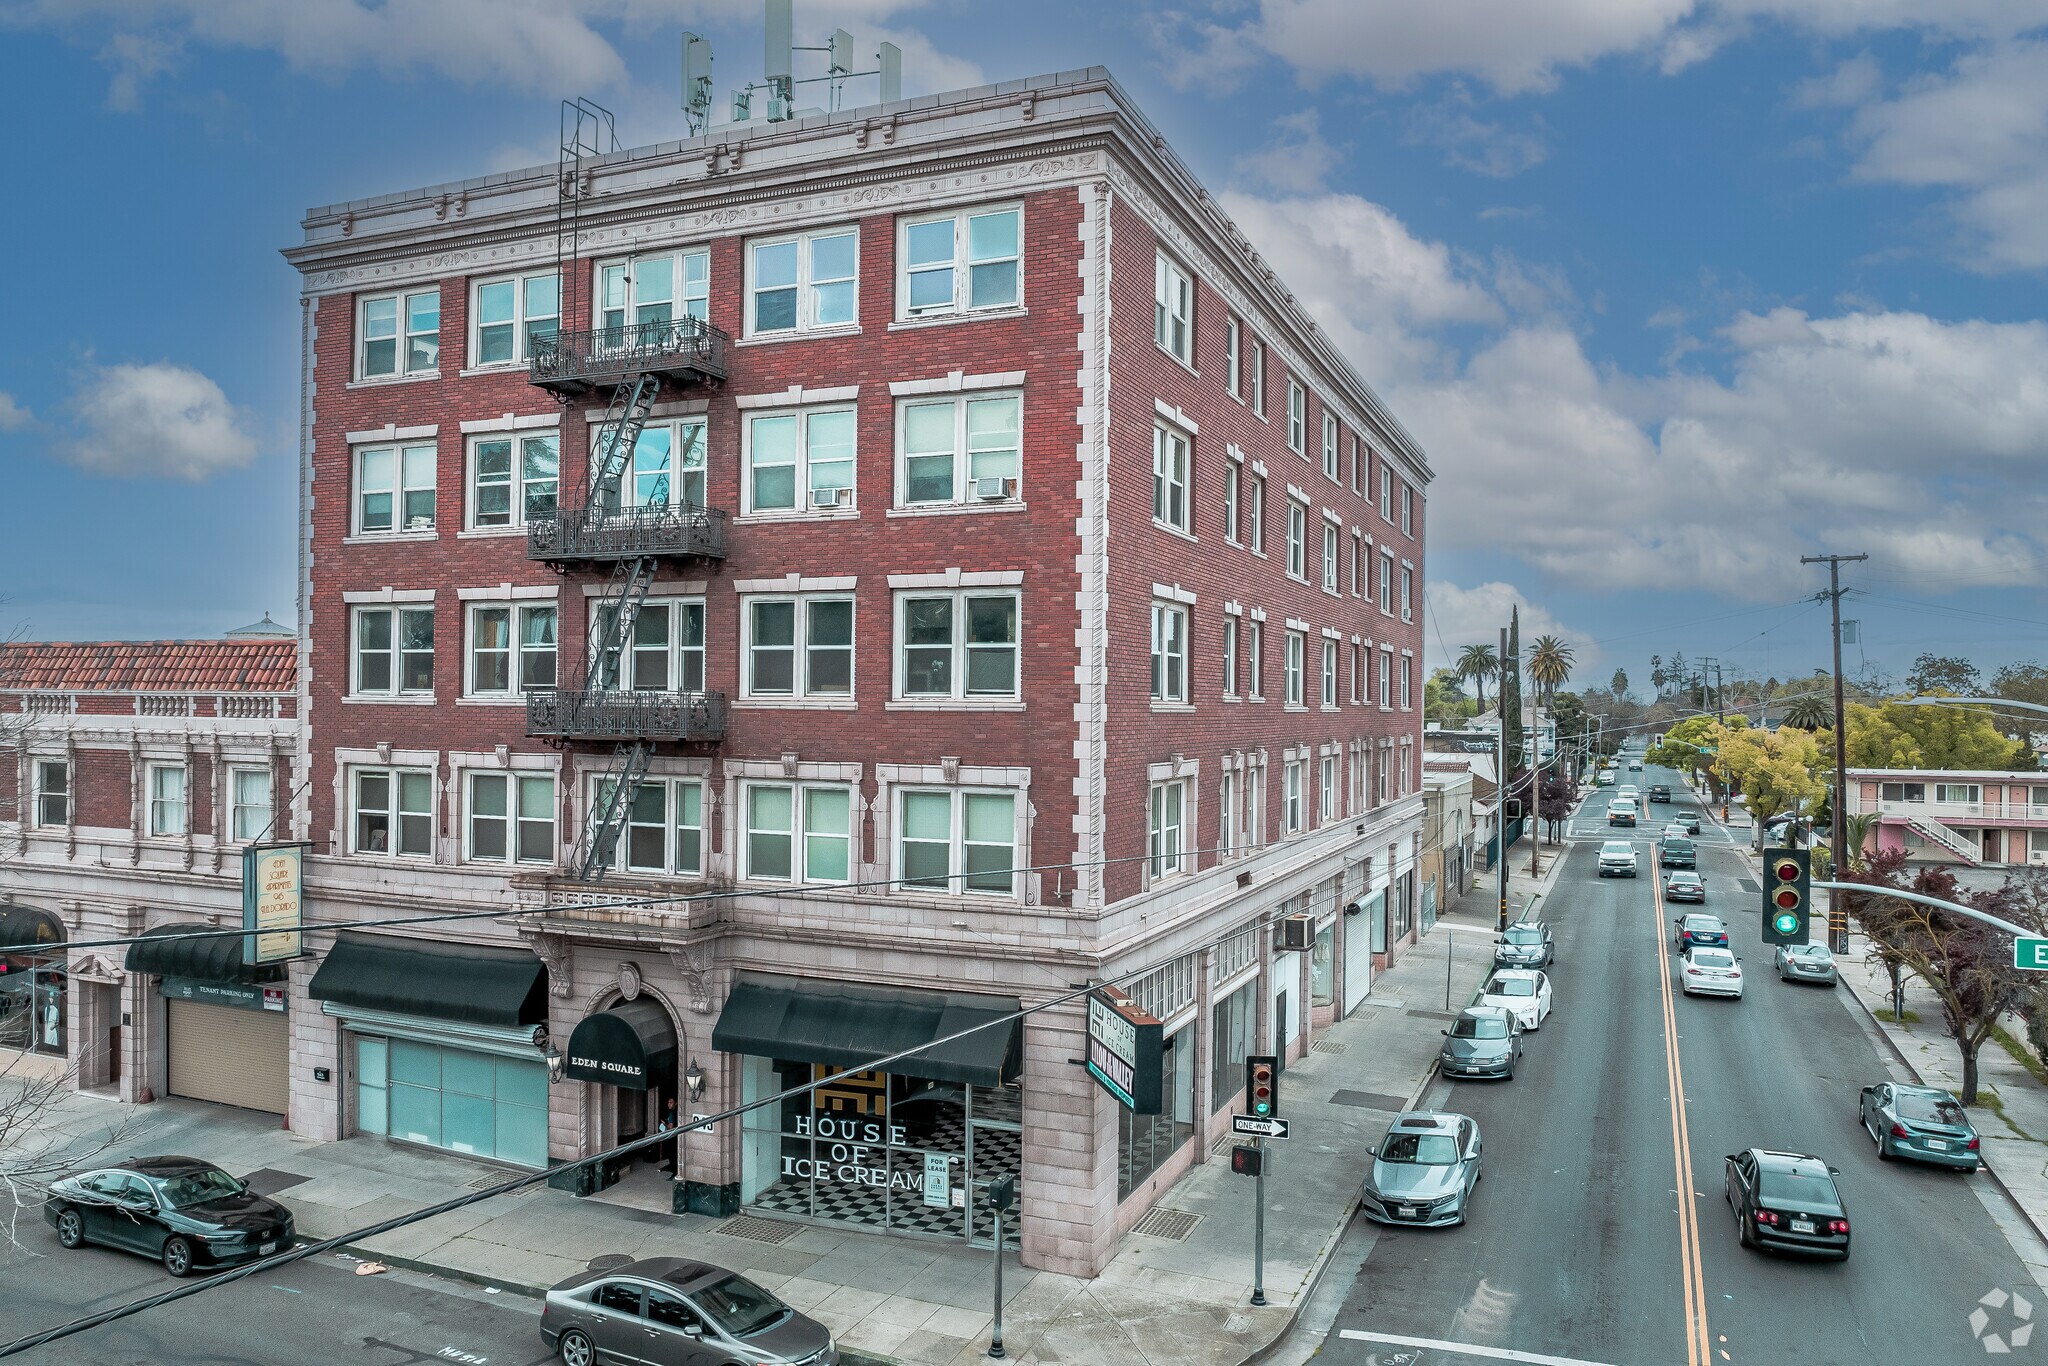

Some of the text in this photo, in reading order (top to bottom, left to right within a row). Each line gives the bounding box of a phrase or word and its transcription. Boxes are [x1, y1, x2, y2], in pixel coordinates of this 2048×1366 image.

[199, 986, 219, 995] TENANT
[220, 989, 242, 998] PARKING
[1106, 1010, 1135, 1043] HOUSE
[1115, 1043, 1134, 1063] CREAM
[571, 1057, 642, 1075] EDEN SQUARE
[795, 1115, 907, 1146] HOUSE
[831, 1144, 868, 1165] OF
[781, 1155, 923, 1192] ICE CREAM
